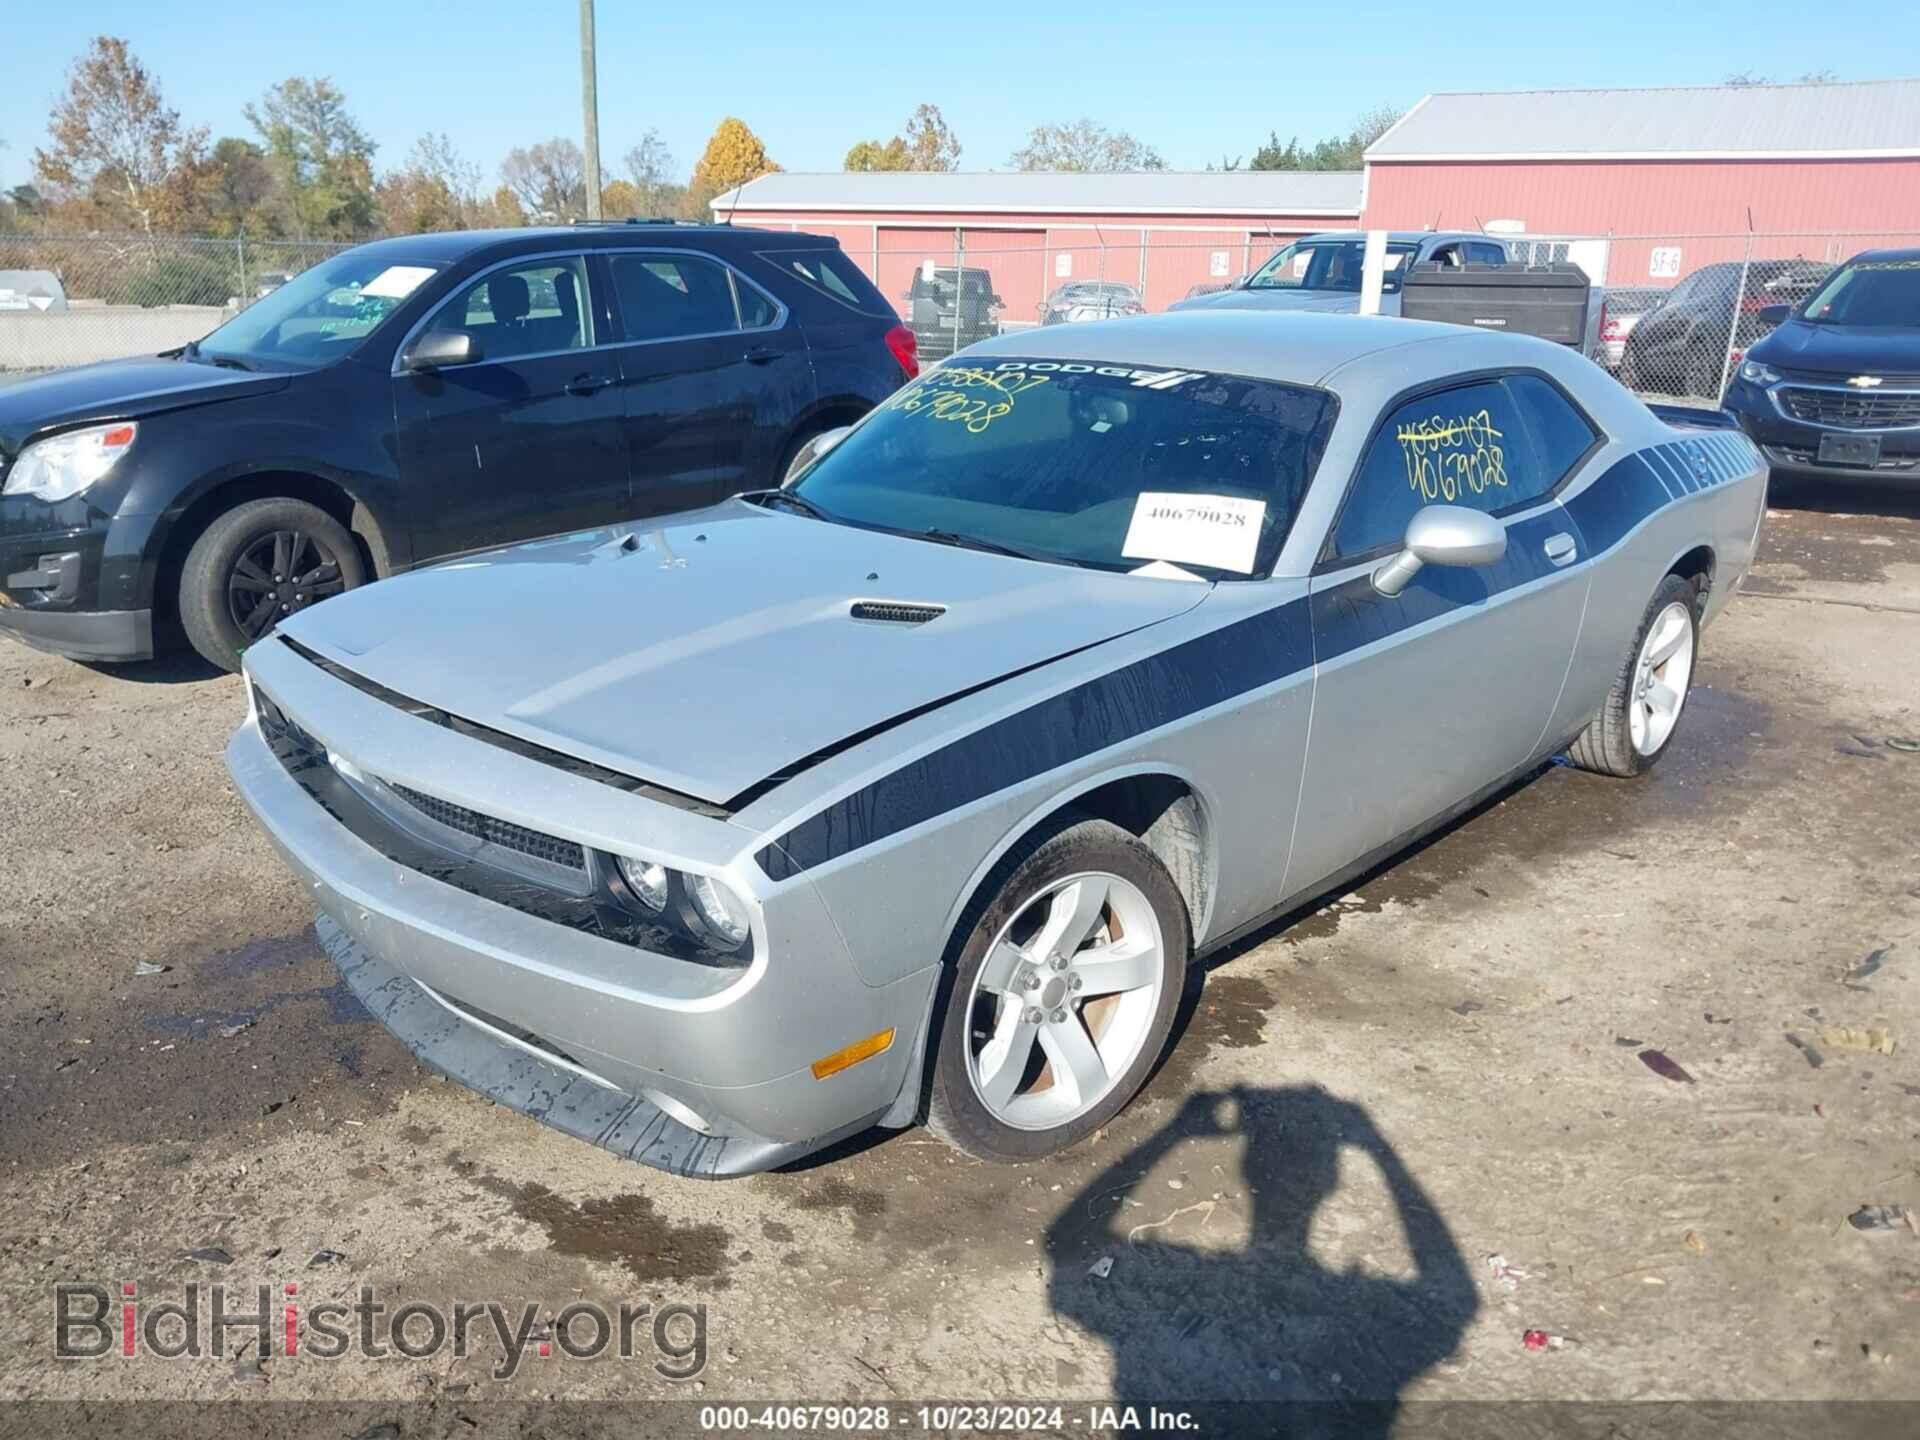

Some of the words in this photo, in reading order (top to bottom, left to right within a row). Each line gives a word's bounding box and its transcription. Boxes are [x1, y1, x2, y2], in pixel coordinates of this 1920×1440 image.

[995, 362, 1160, 380] DODGE
[1404, 445, 1508, 504] 40679028
[1146, 506, 1247, 527] 40679028
